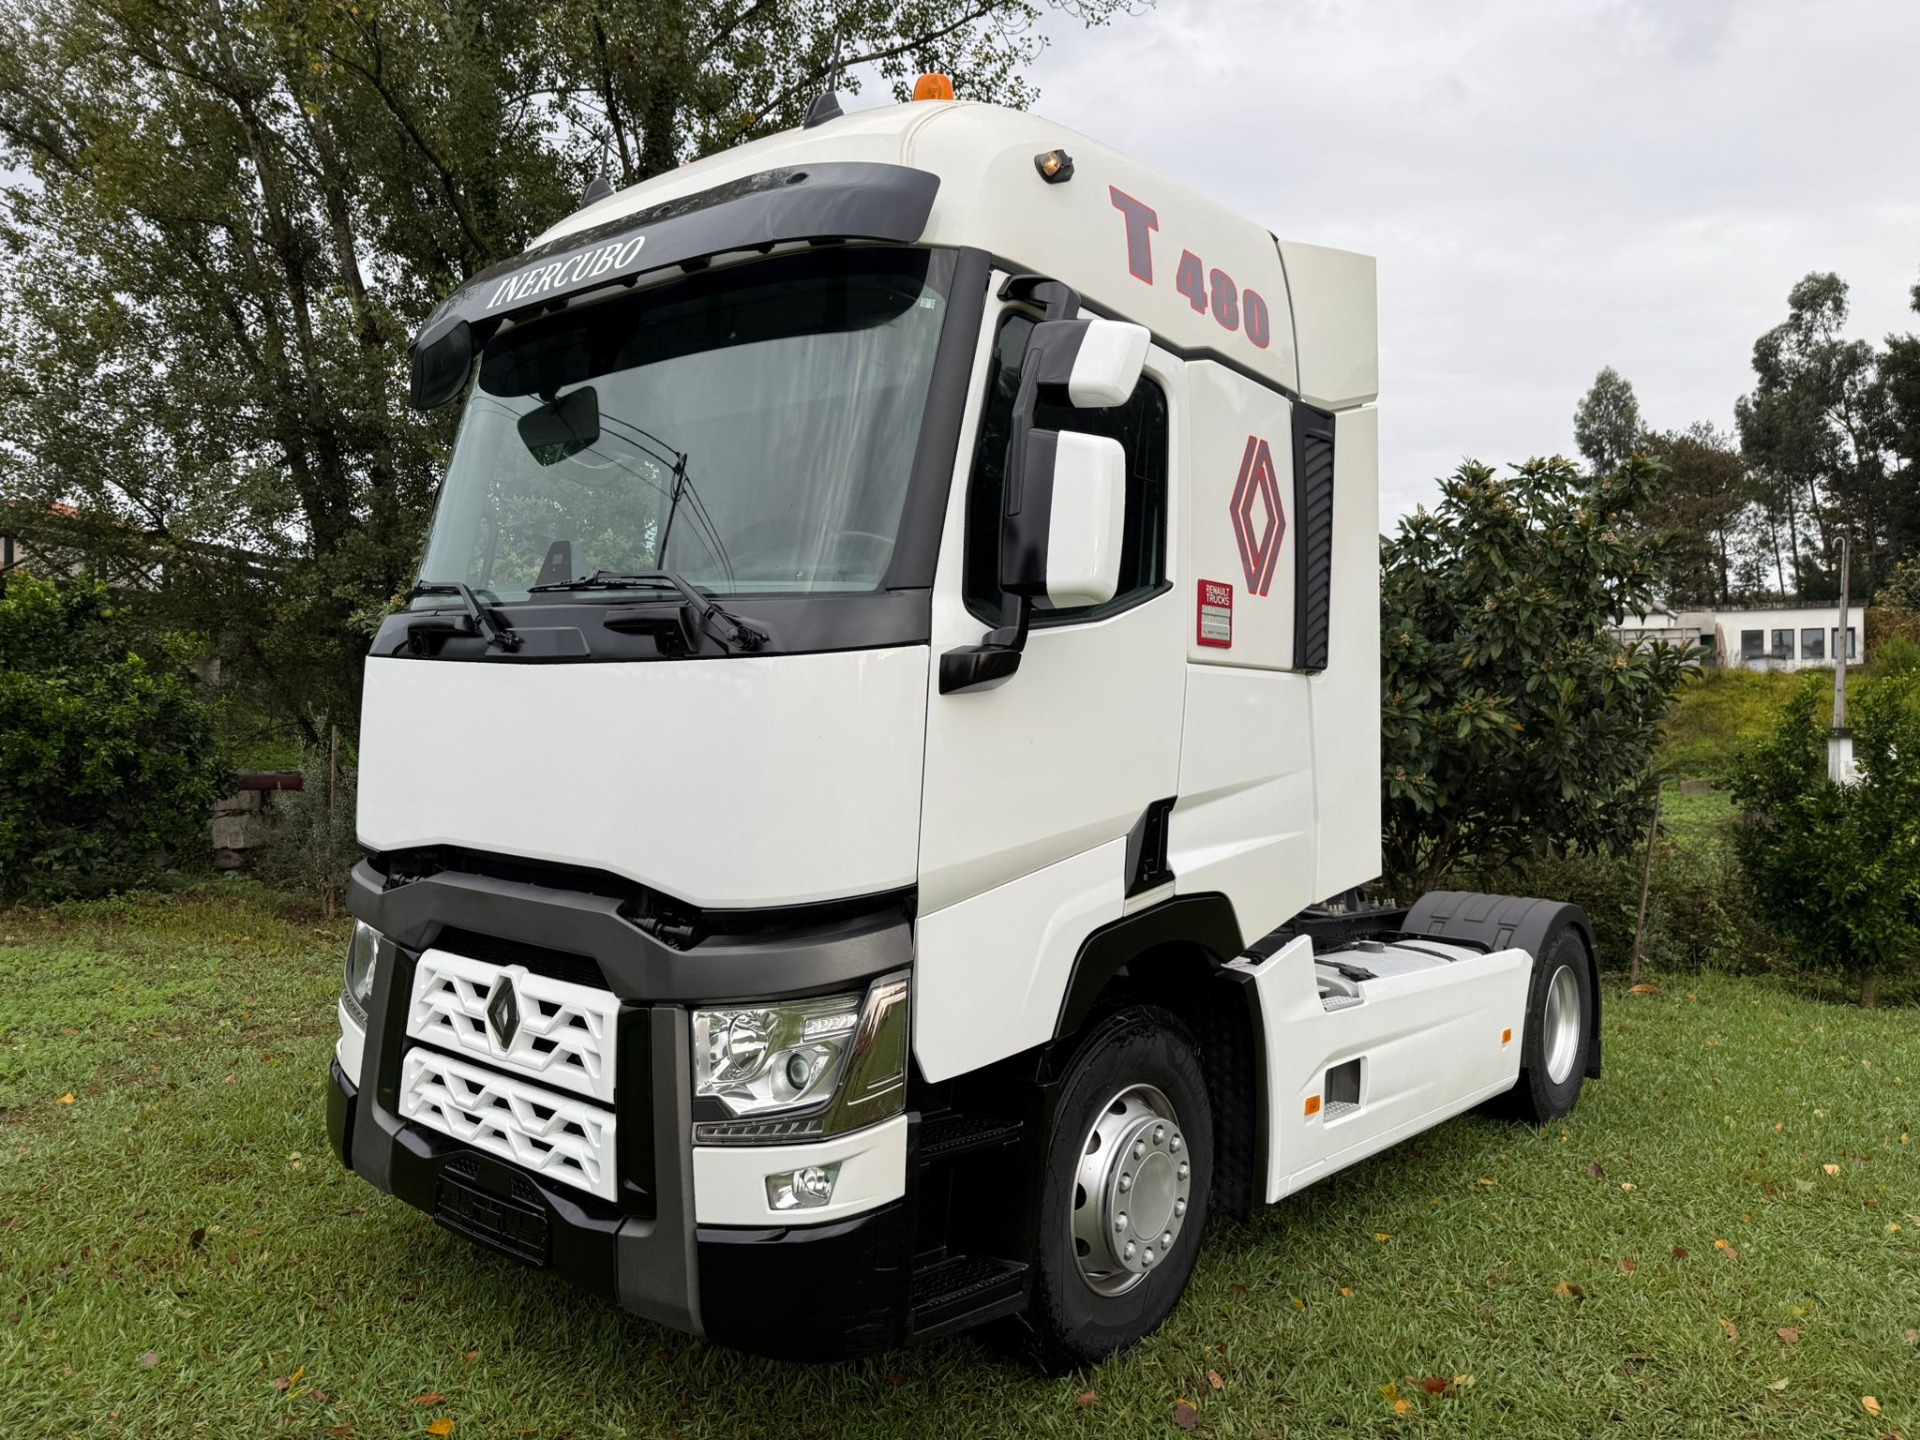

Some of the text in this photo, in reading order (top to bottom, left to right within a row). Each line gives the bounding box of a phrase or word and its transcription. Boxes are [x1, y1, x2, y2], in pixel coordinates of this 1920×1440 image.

[485, 235, 646, 310] INERCUBO
[1109, 184, 1270, 349] T 480
[1205, 584, 1230, 597] RENAULT
[1206, 593, 1230, 606] TRUCKS
